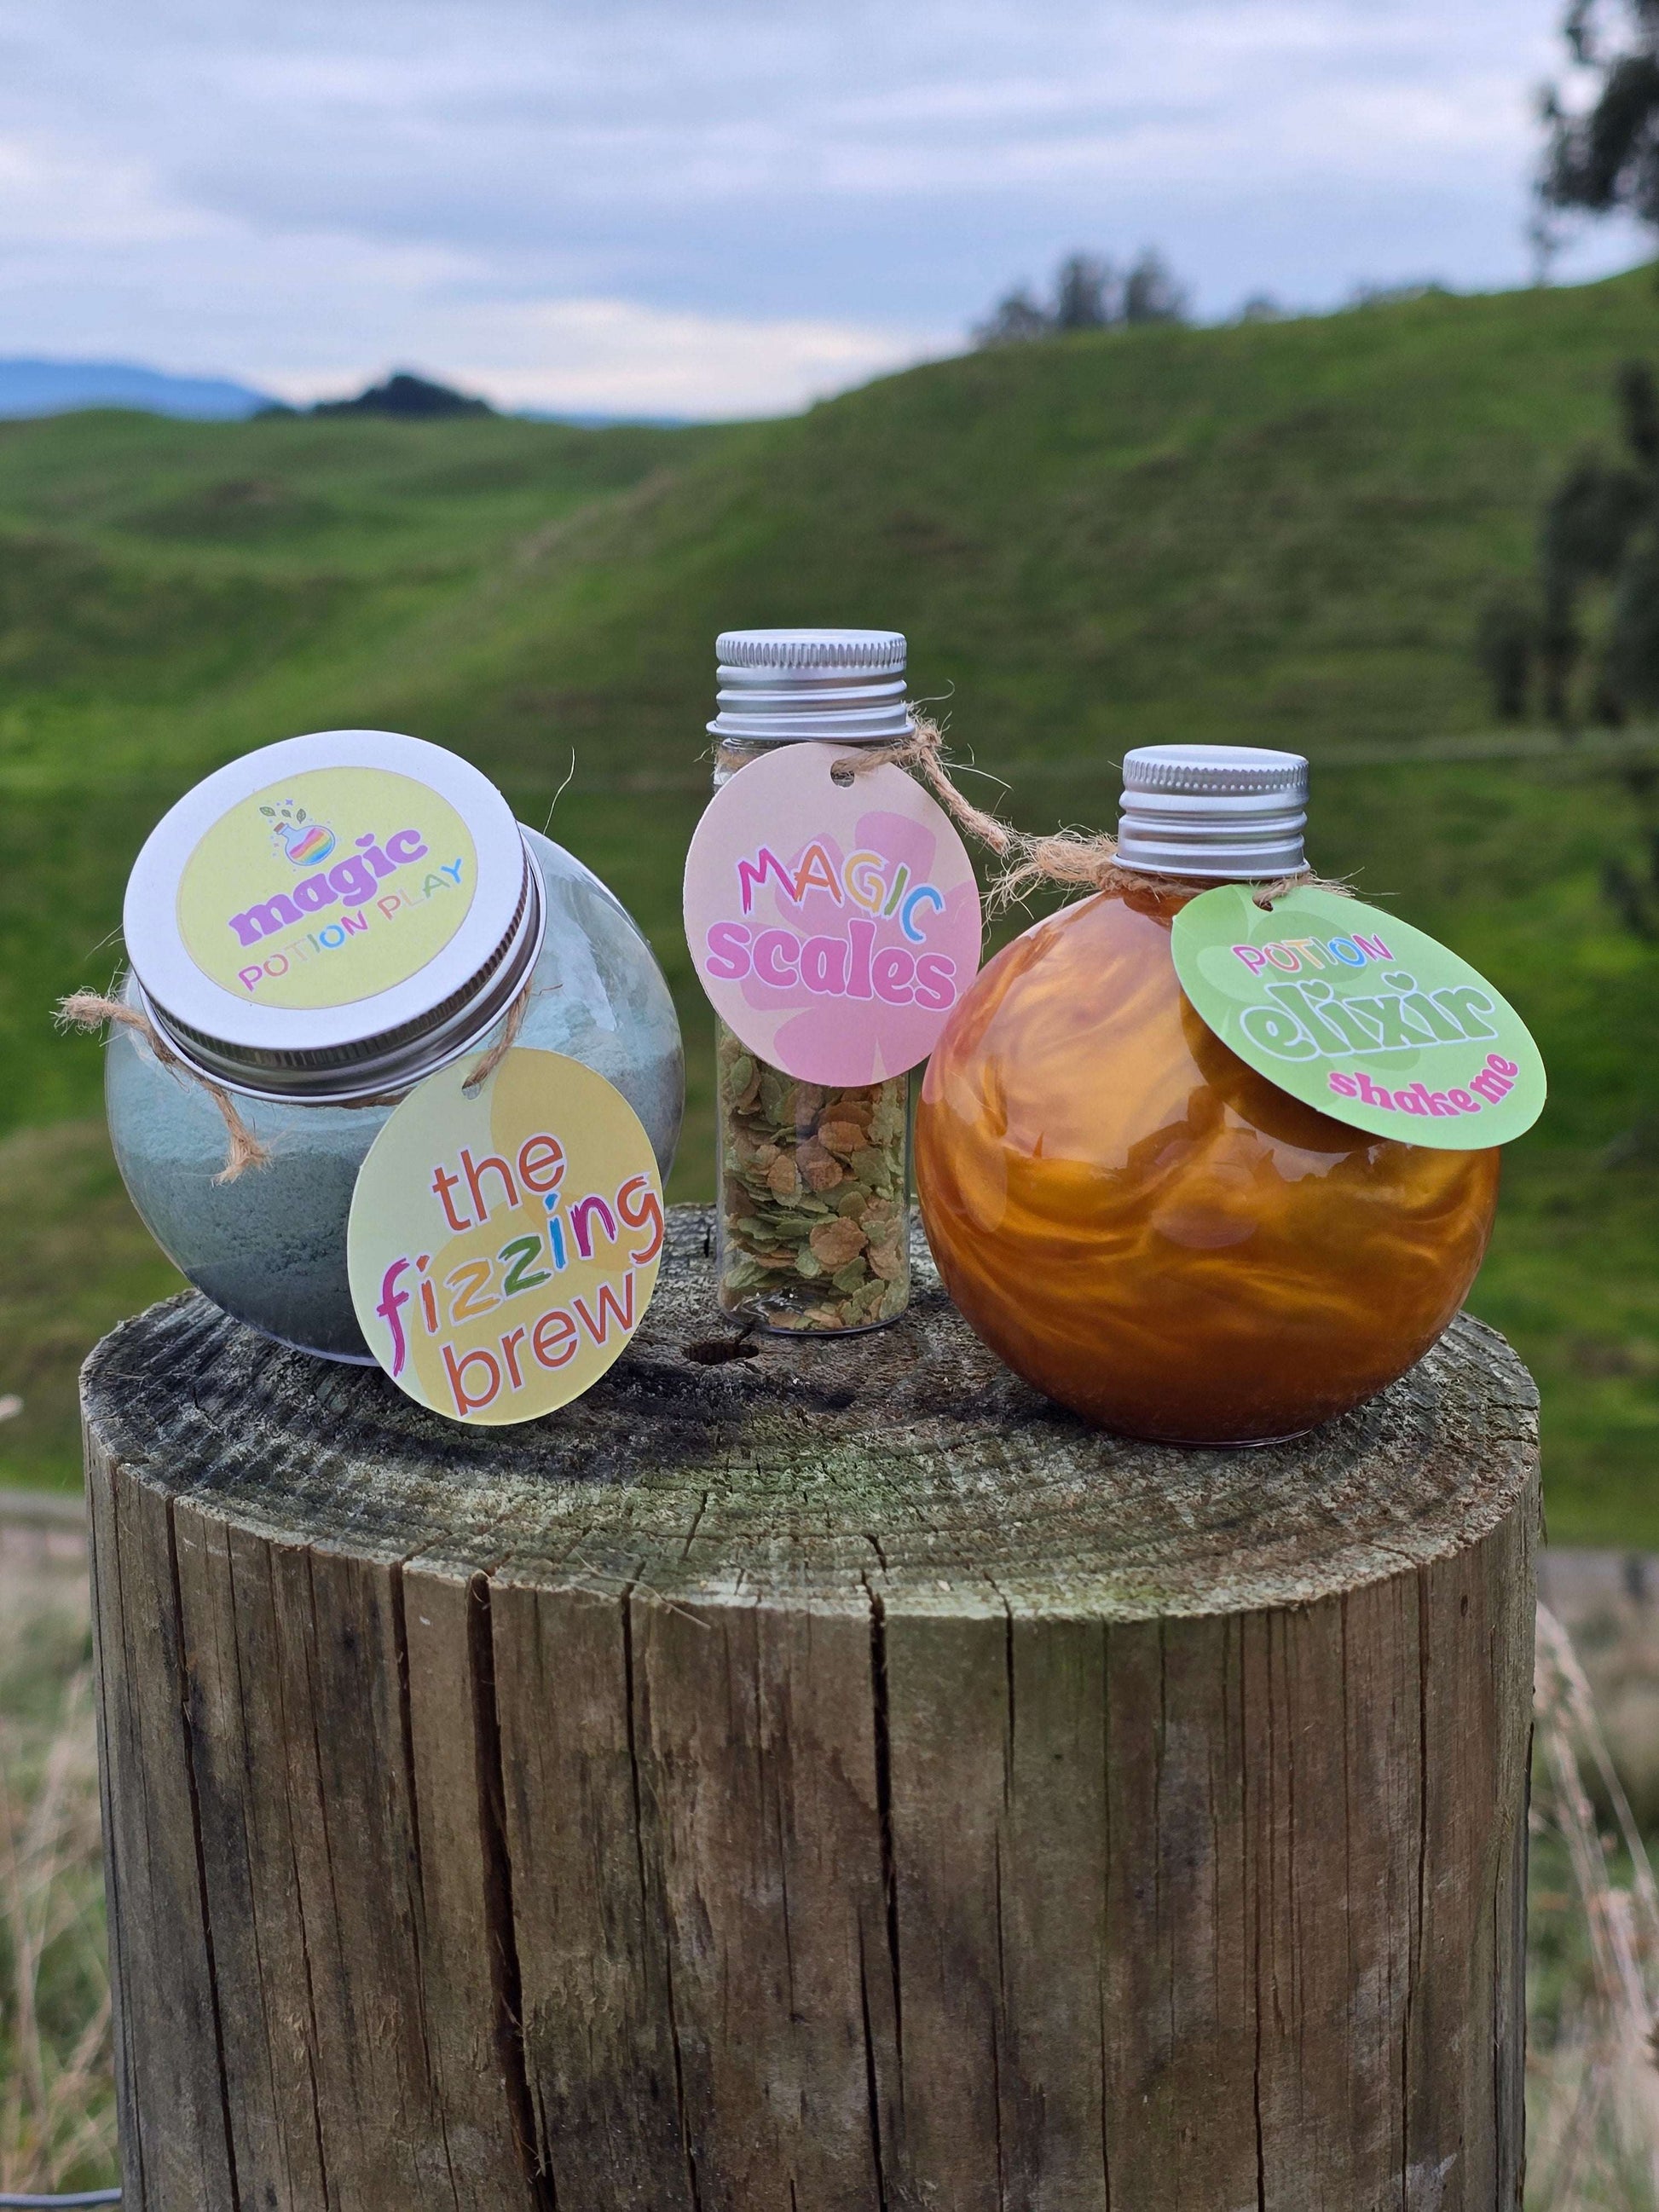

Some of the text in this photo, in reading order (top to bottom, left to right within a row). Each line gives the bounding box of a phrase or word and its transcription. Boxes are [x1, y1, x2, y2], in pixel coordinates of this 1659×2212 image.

[228, 829, 429, 947] magic
[238, 858, 463, 992] POTION PLAY
[737, 844, 944, 942] MAGIC
[705, 918, 957, 1011] scales
[1232, 933, 1395, 976] POTION
[1240, 970, 1499, 1062] elixir
[1327, 1053, 1519, 1118] shake me
[431, 1135, 565, 1232] the
[376, 1175, 664, 1377] fizzing
[442, 1271, 634, 1418] brew
